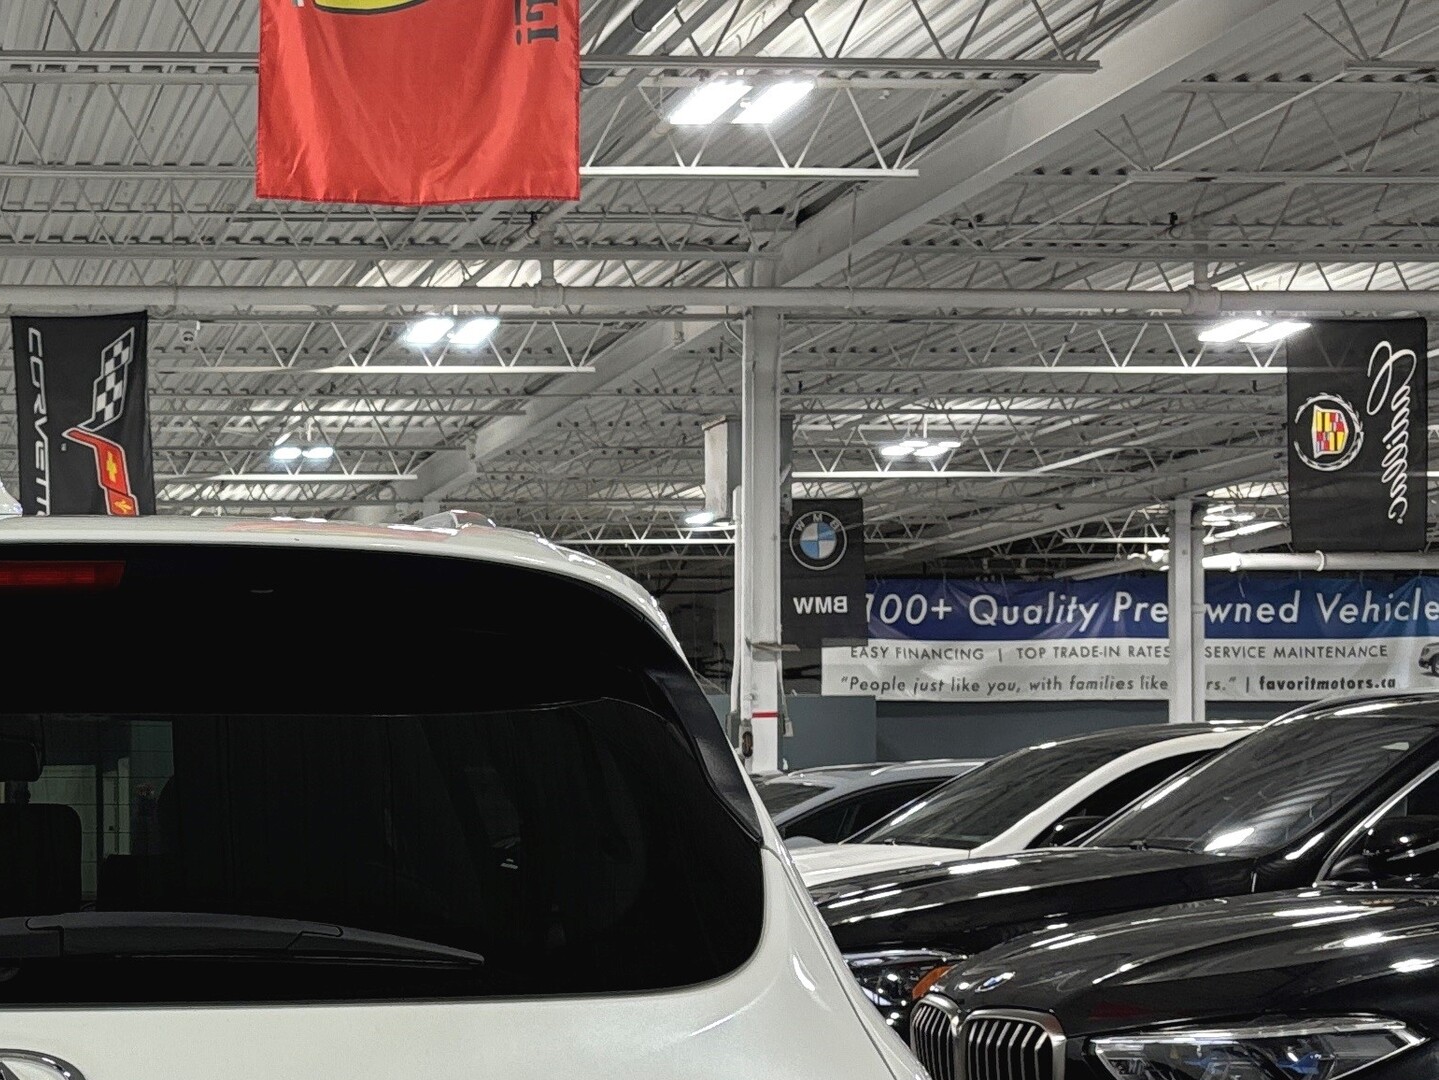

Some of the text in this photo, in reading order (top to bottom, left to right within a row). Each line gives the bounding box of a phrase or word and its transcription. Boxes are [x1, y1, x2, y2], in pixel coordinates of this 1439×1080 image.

[28, 327, 50, 516] CORVETT
[865, 593, 953, 625] 100+
[969, 591, 1099, 632] Quality
[1316, 587, 1439, 624] Vehicle
[850, 645, 1389, 660] EASY FINANCING TOP TRADE-IN RATES SERVICE MAINTENANCE
[841, 676, 906, 694] "People
[913, 678, 944, 694] just
[951, 677, 980, 692] like
[987, 681, 1021, 695] you,
[1029, 676, 1062, 690] with
[1069, 675, 1134, 690] families
[1140, 675, 1168, 690] like
[1259, 676, 1396, 690] favoritmotors.ca
